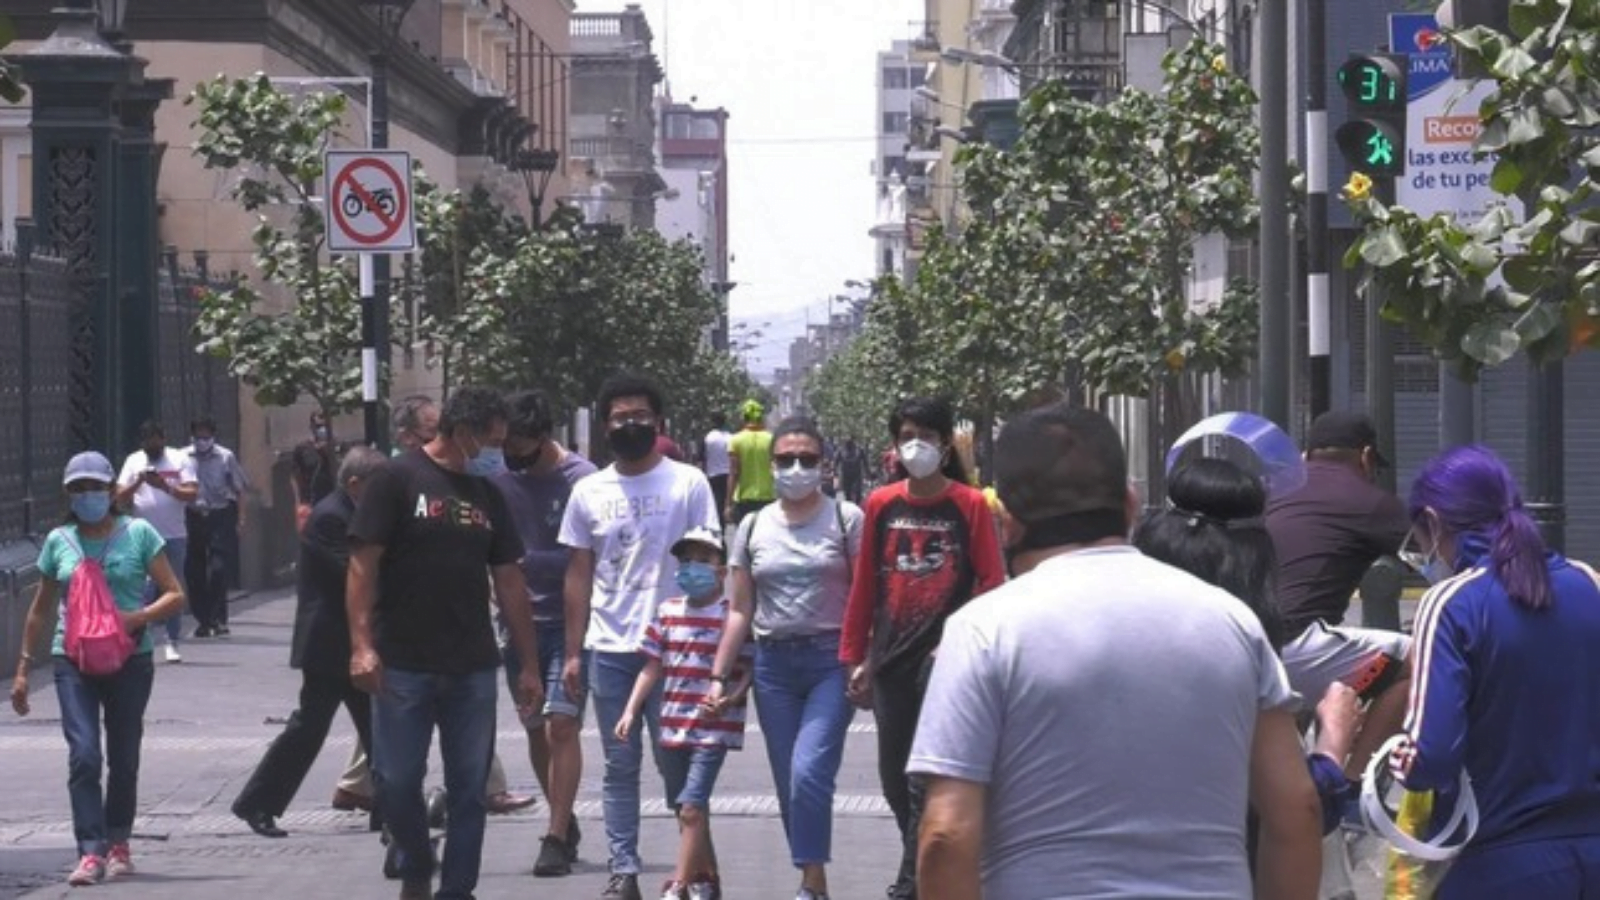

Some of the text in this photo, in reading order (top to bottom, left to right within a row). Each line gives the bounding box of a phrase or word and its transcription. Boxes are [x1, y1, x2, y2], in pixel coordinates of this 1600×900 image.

[1360, 66, 1397, 101] 31
[1408, 148, 1435, 166] las
[1412, 171, 1435, 189] de
[1440, 171, 1461, 188] tu
